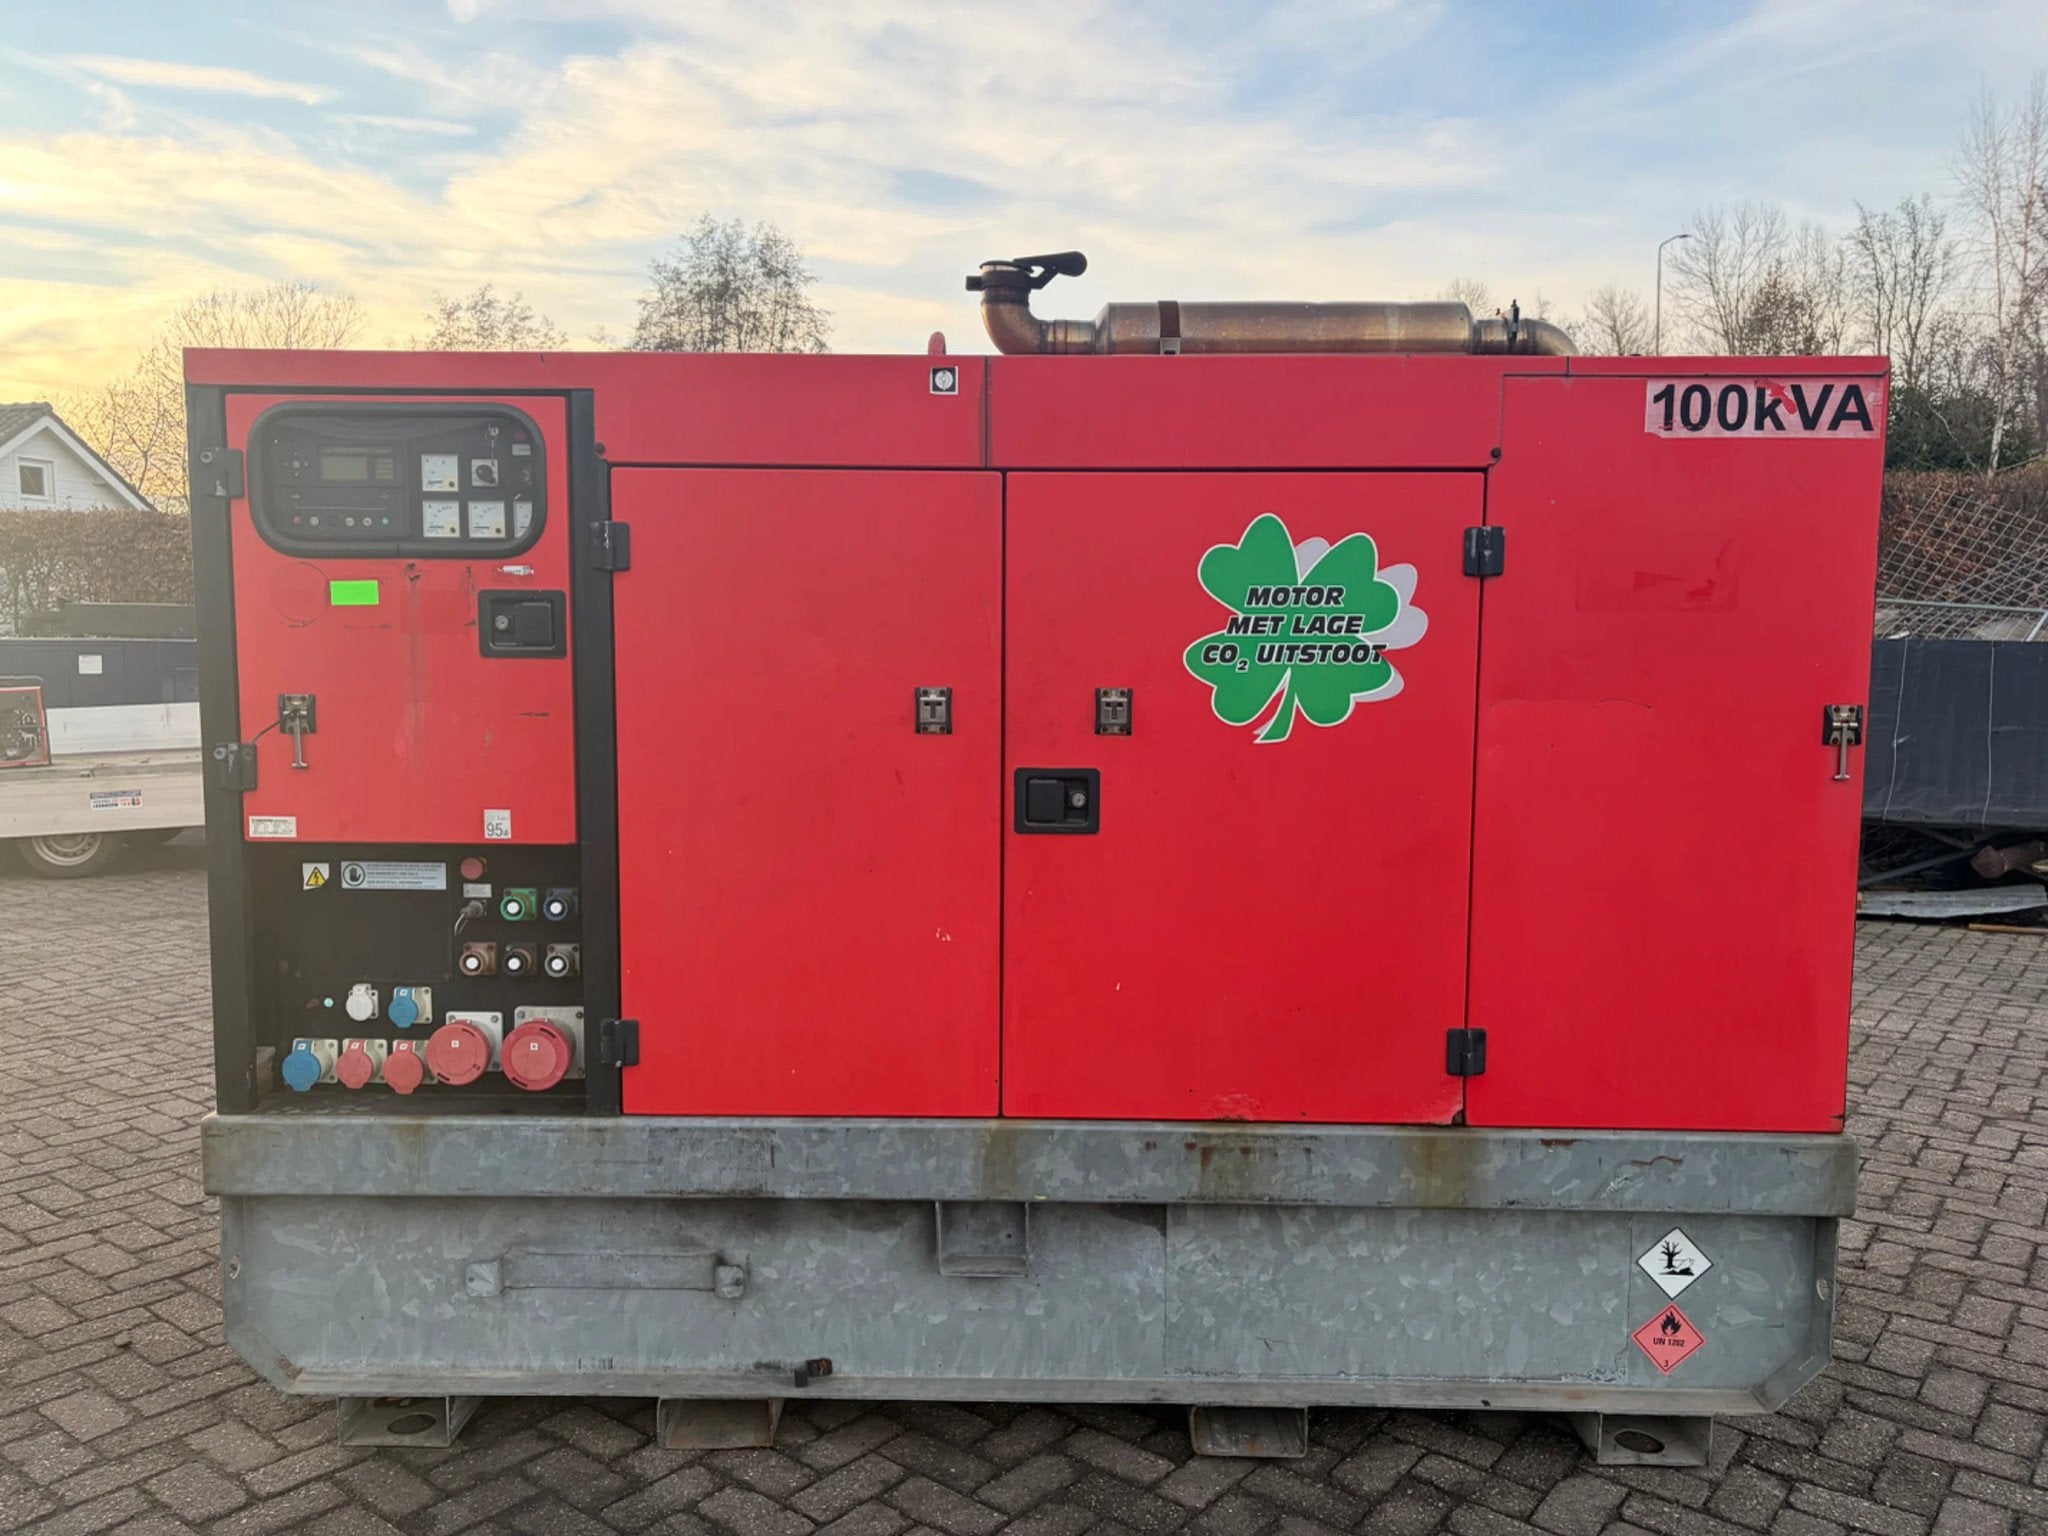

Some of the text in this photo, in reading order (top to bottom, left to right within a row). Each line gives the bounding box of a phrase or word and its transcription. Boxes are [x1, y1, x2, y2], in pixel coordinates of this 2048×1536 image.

[1653, 384, 1873, 431] 100kVA
[1246, 586, 1343, 606] MOTOR
[1227, 615, 1362, 635] MET LAGE
[1257, 643, 1388, 664] UITSTOOT
